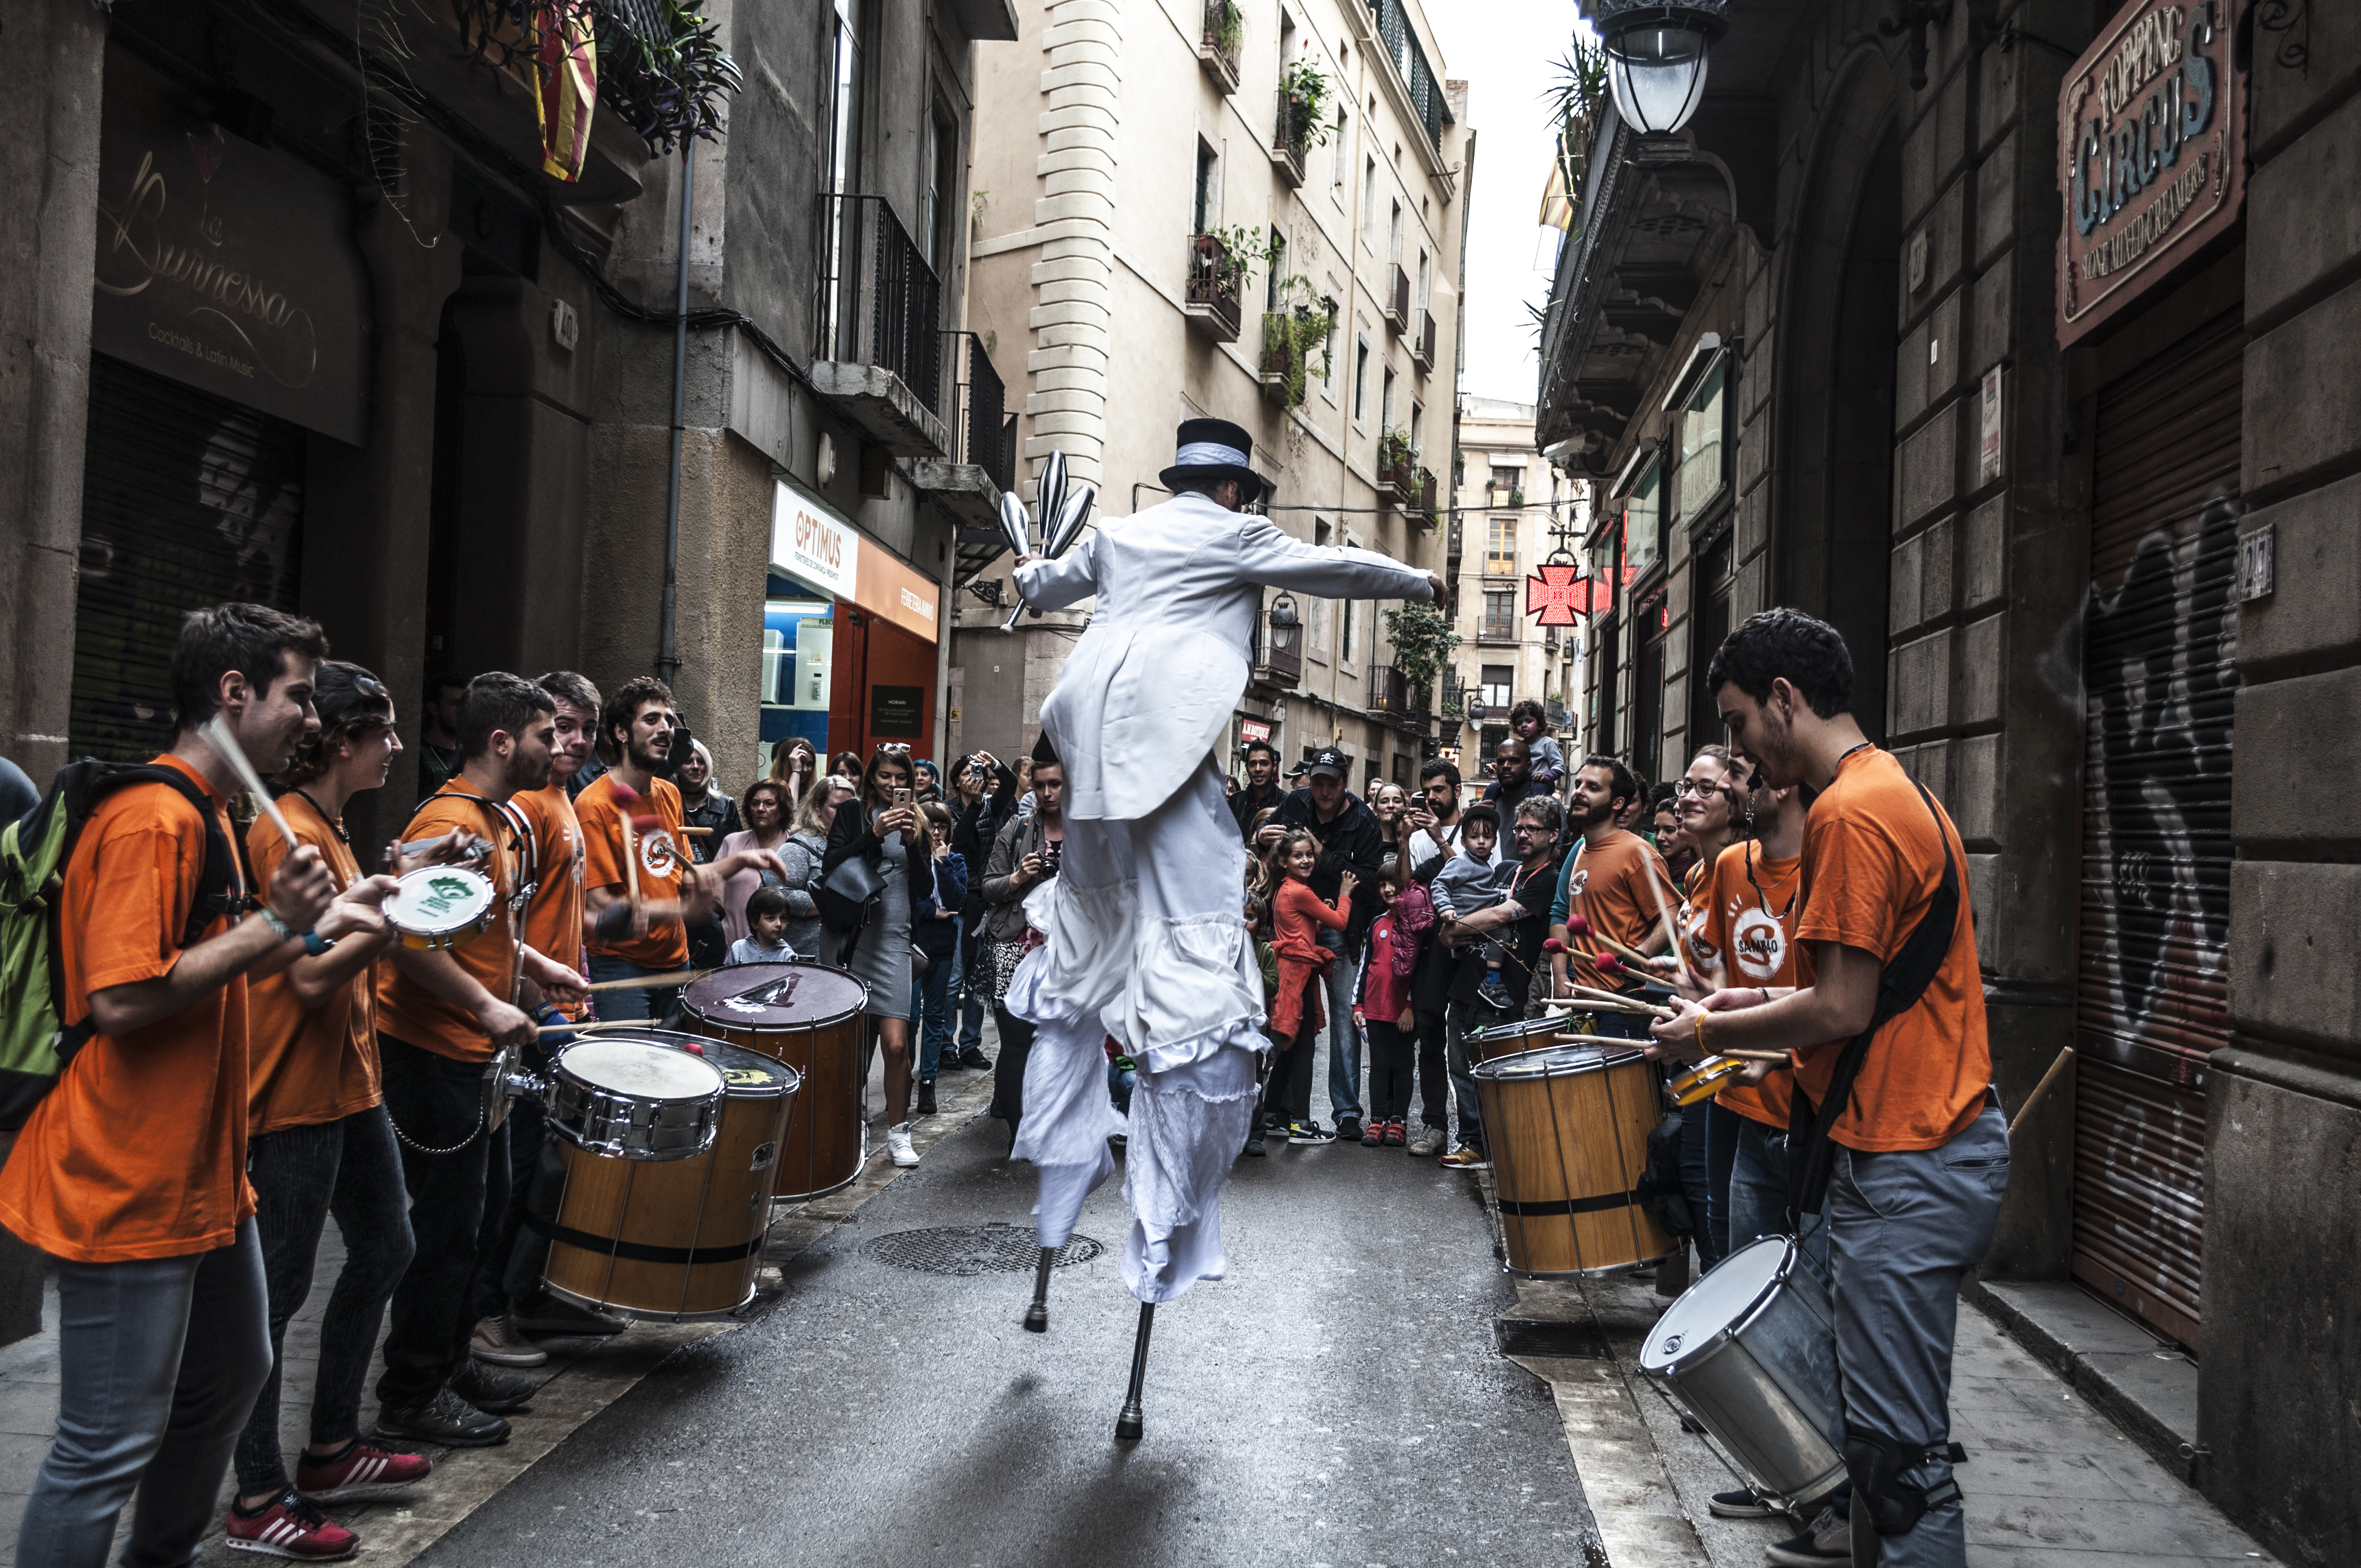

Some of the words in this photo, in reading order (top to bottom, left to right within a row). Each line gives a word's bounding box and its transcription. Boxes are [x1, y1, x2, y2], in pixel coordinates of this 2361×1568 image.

[2098, 5, 2183, 133] TOPPING
[2074, 1, 2213, 236] CIRCUS
[149, 322, 193, 354] Cocktails
[195, 342, 203, 358] &
[205, 345, 227, 367] Latin
[229, 356, 255, 378] Music
[562, 312, 572, 341] 40
[796, 510, 841, 569] OPTIMUS
[2245, 541, 2265, 588] 27
[1739, 939, 1778, 953] SAMBAO
